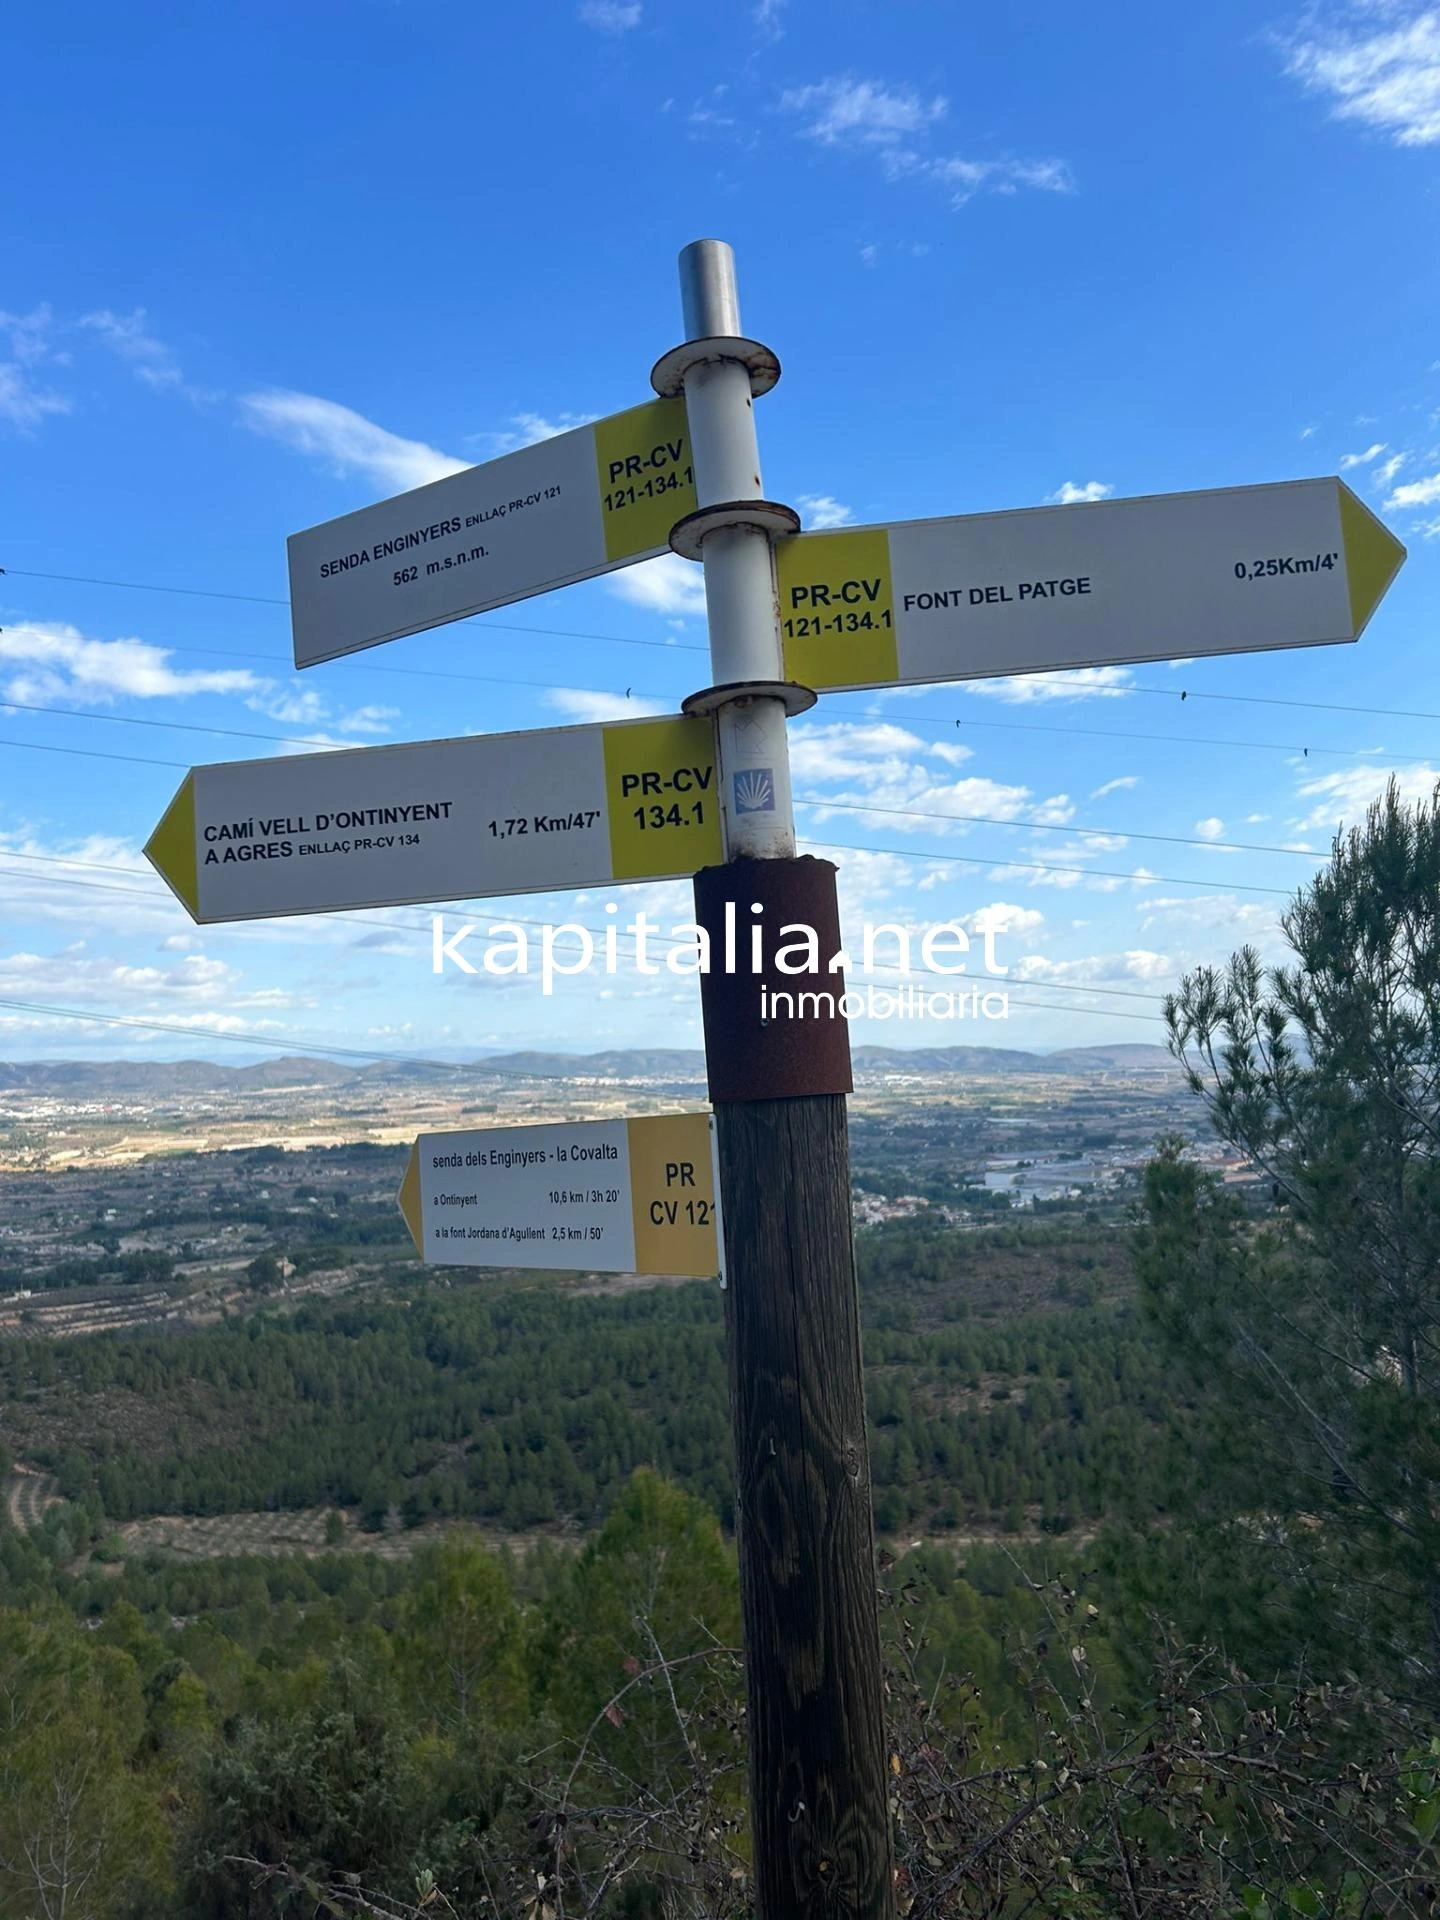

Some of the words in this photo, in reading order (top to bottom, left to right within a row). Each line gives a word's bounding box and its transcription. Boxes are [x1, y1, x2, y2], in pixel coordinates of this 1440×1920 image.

[609, 439, 683, 484] PR-CV
[604, 466, 693, 511] 121-134.1
[320, 550, 370, 578] SENDA
[373, 517, 461, 560] ENGINYERS
[465, 505, 506, 528] ENLLAÇ
[509, 492, 541, 513] PR-CV
[544, 485, 561, 499] 121
[393, 566, 418, 586] 562
[426, 546, 489, 575] m.s.n.m.
[1234, 553, 1338, 581] 0,25Km/4'
[791, 578, 881, 609] PR-CV
[903, 590, 962, 611] FONT
[969, 586, 1013, 605] DEL
[1018, 577, 1092, 600] PATGE
[784, 609, 891, 638] 121-134.1
[622, 766, 713, 797] PR-CV
[204, 817, 254, 842] CAMÍ
[259, 817, 310, 836] VELL
[316, 802, 452, 831] D'ONTINYENT
[488, 818, 528, 839] 1,72
[534, 811, 601, 833] Km/47'
[633, 801, 704, 830] 134.1
[204, 848, 219, 865] A
[223, 841, 293, 863] AGRES
[299, 840, 350, 856] ENLLAÇ
[355, 836, 395, 851] PR-CV
[399, 833, 420, 846] 134
[432, 1152, 463, 1168] senda
[465, 1150, 487, 1167] dels
[490, 1149, 546, 1169] Enginyers
[557, 1146, 567, 1162] la
[571, 1143, 618, 1161] Covalta
[665, 1162, 696, 1187] PR
[434, 1196, 439, 1206] a
[440, 1193, 478, 1208] Ontinyent
[549, 1191, 568, 1205] 10,6
[569, 1191, 584, 1203] km
[591, 1190, 604, 1203] 3h
[650, 1200, 678, 1225] CV
[435, 1229, 440, 1238] a
[442, 1227, 449, 1238] la
[450, 1227, 466, 1239] font
[467, 1227, 500, 1239] Jordana
[552, 1226, 566, 1241] 2,5
[567, 1226, 582, 1240] km
